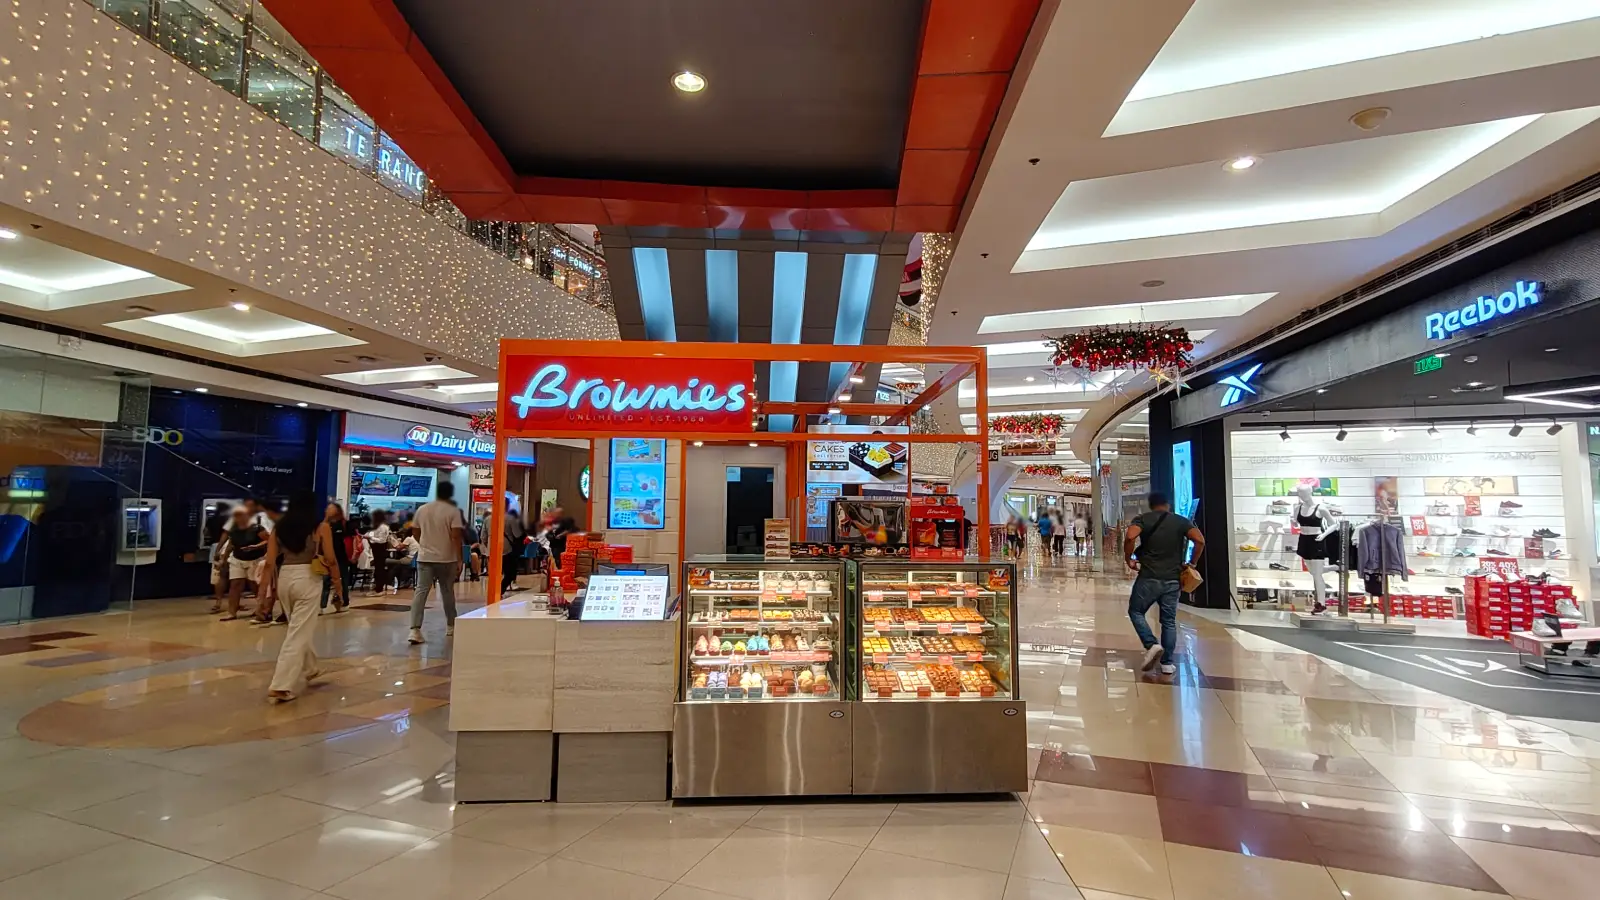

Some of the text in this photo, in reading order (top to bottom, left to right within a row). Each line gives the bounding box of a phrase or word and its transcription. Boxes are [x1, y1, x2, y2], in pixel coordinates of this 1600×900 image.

[1425, 280, 1539, 340] Reebok
[511, 364, 746, 419] Brownies
[569, 413, 634, 422] UNLIMITED
[132, 427, 183, 446] BDO
[412, 430, 496, 453] DQ Dairy Quee
[814, 445, 845, 453] CAKES
[994, 569, 1006, 577] 37
